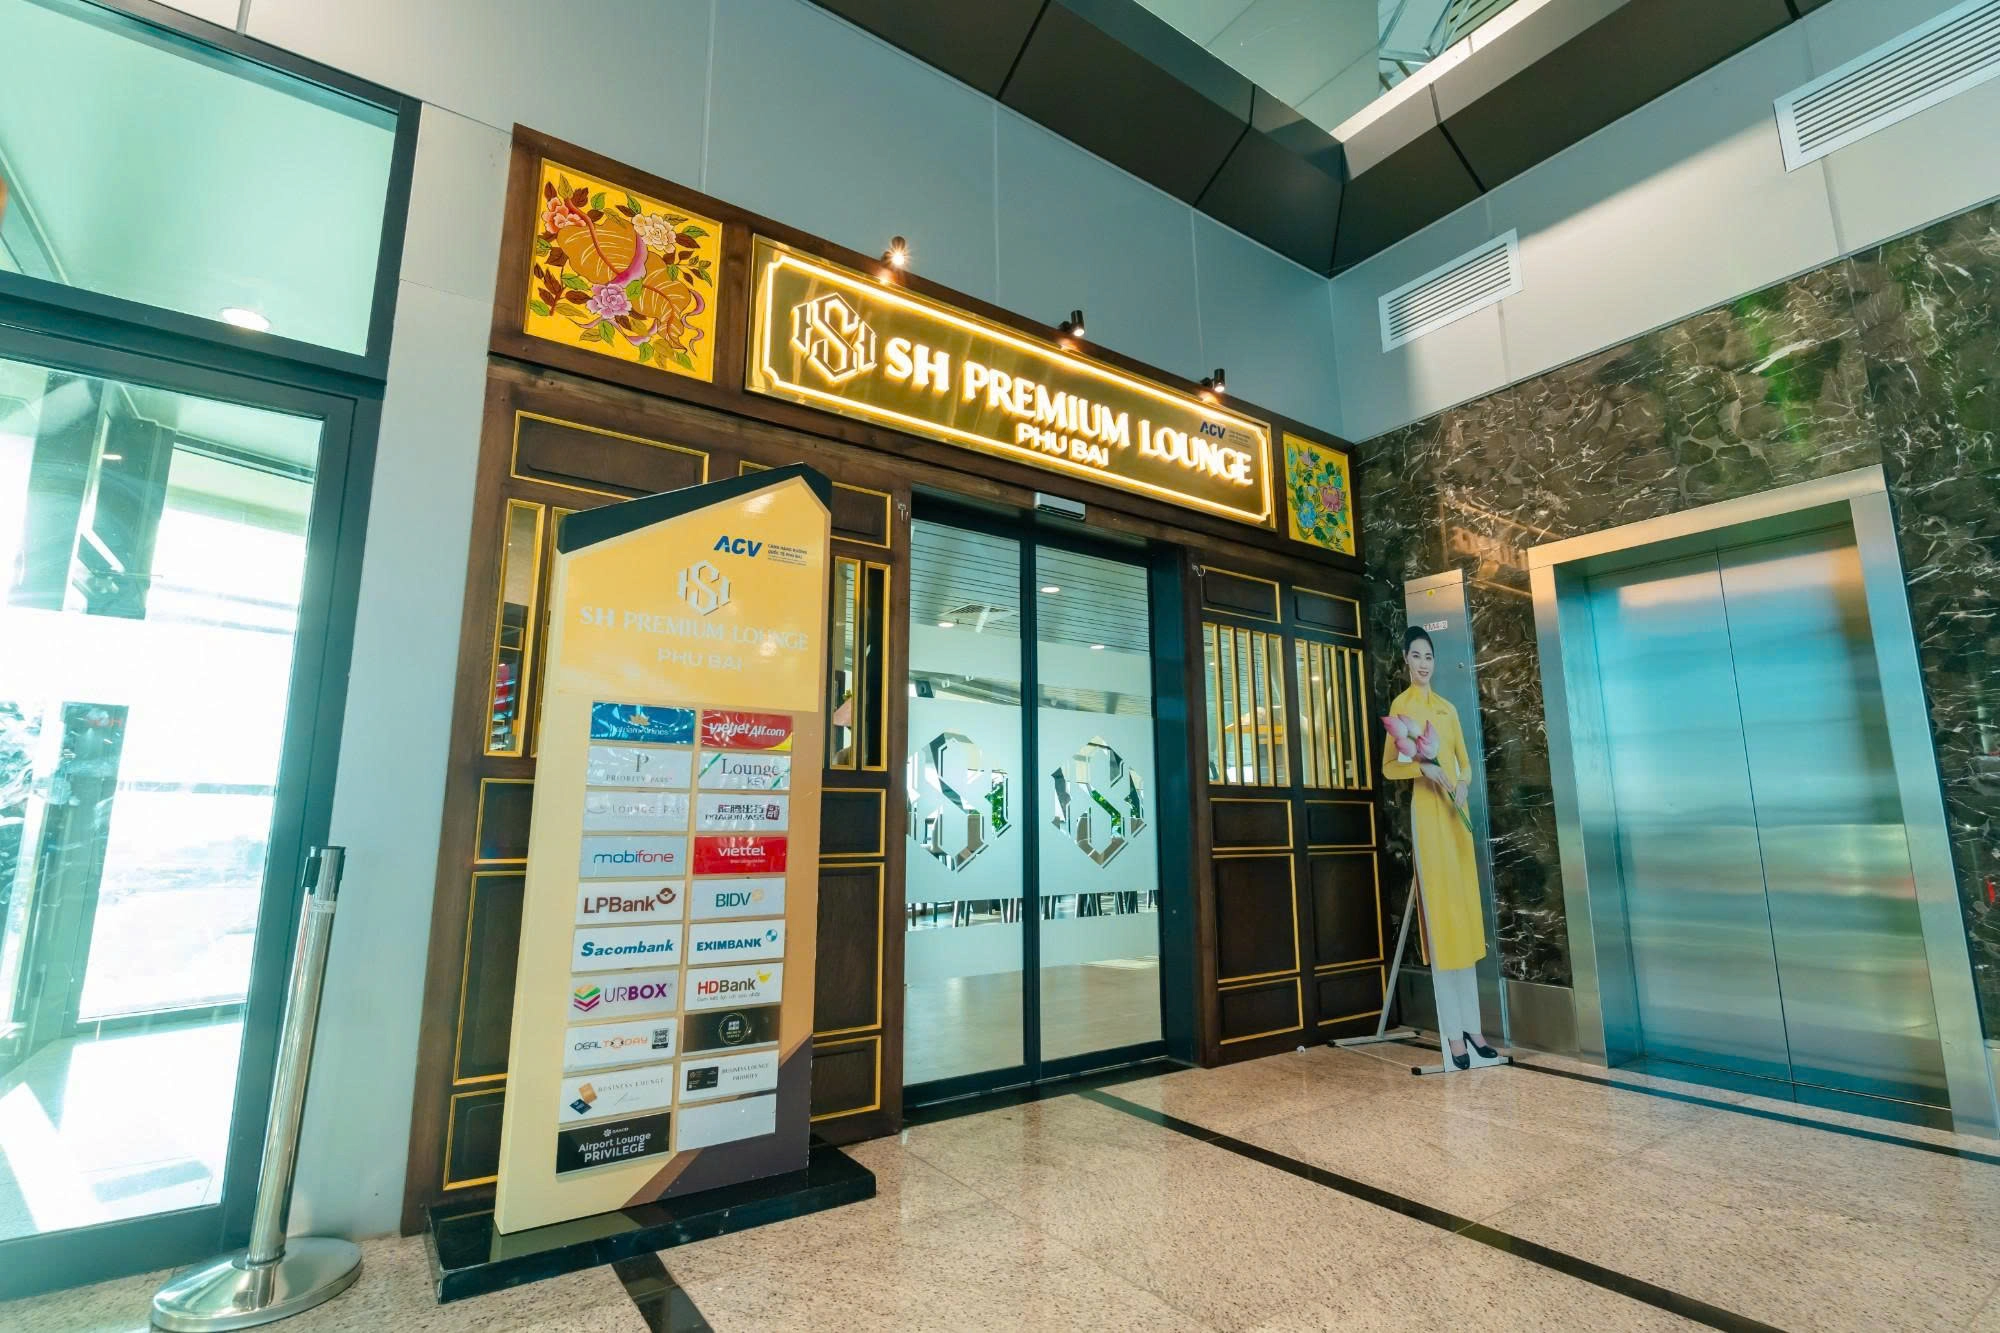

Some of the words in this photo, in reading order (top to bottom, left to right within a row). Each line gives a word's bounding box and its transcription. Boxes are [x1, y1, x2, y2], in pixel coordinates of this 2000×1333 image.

[885, 337, 950, 394] SH
[962, 360, 1130, 450] PREMIUM
[1138, 420, 1253, 486] LOUNGE
[1200, 421, 1226, 439] ACV
[1016, 423, 1067, 455] PHU
[1069, 439, 1109, 467] BAI
[713, 535, 763, 557] ACV
[579, 606, 615, 628] SH
[623, 611, 724, 641] PREMIUM
[733, 626, 808, 652] LOUNGE
[656, 647, 702, 667] PHU
[707, 653, 743, 673] BAI
[721, 758, 780, 777] Lounge
[593, 849, 675, 864] mobifone
[718, 846, 766, 857] viettel
[583, 896, 656, 914] LPBank
[715, 892, 751, 908] BIDV
[581, 939, 674, 957] Sacombank
[696, 938, 762, 952] EXIMBANK
[604, 983, 667, 1003] URBOX
[697, 975, 756, 995] HDBank
[578, 1139, 613, 1153] Airport
[616, 1133, 651, 1145] Lounge
[584, 1142, 645, 1163] PRIVILEGE
